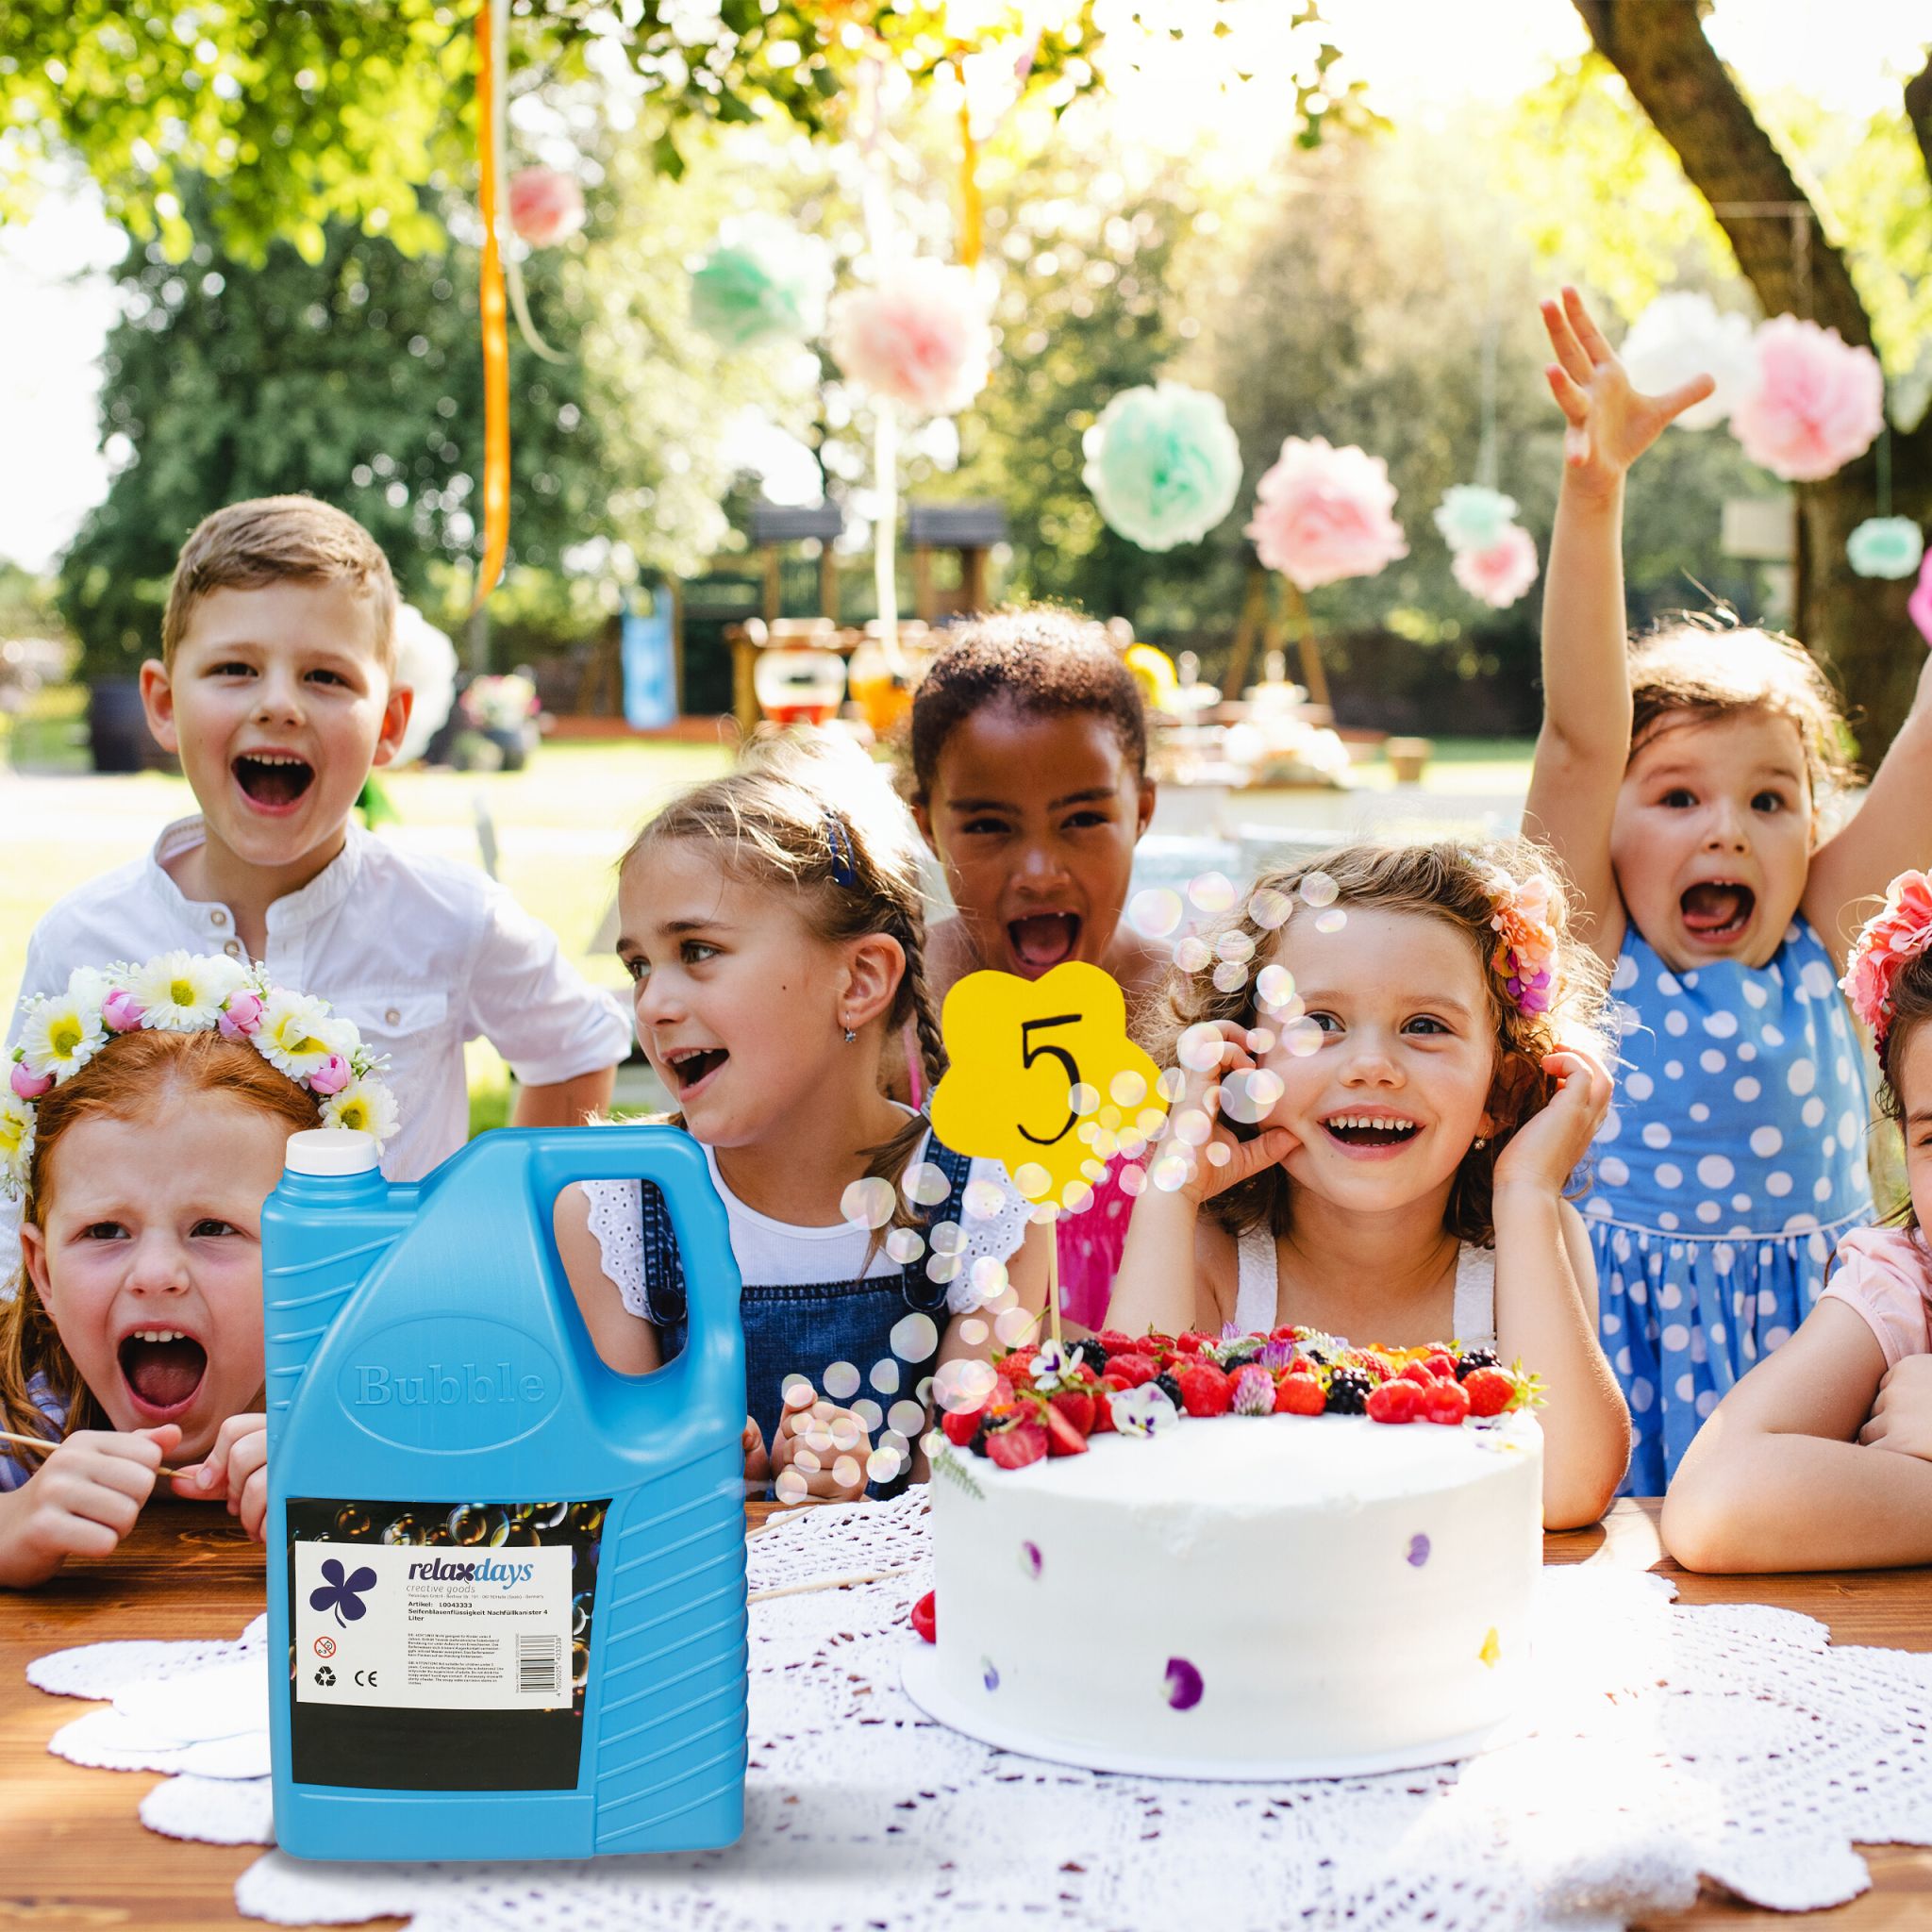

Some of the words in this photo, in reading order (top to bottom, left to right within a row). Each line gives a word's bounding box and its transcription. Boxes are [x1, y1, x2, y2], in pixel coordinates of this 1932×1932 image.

[1016, 1013, 1083, 1146] 5
[354, 1362, 546, 1406] Bubble
[406, 1584, 444, 1593] creative
[446, 1585, 475, 1594] goods
[408, 1557, 534, 1591] relaxdays
